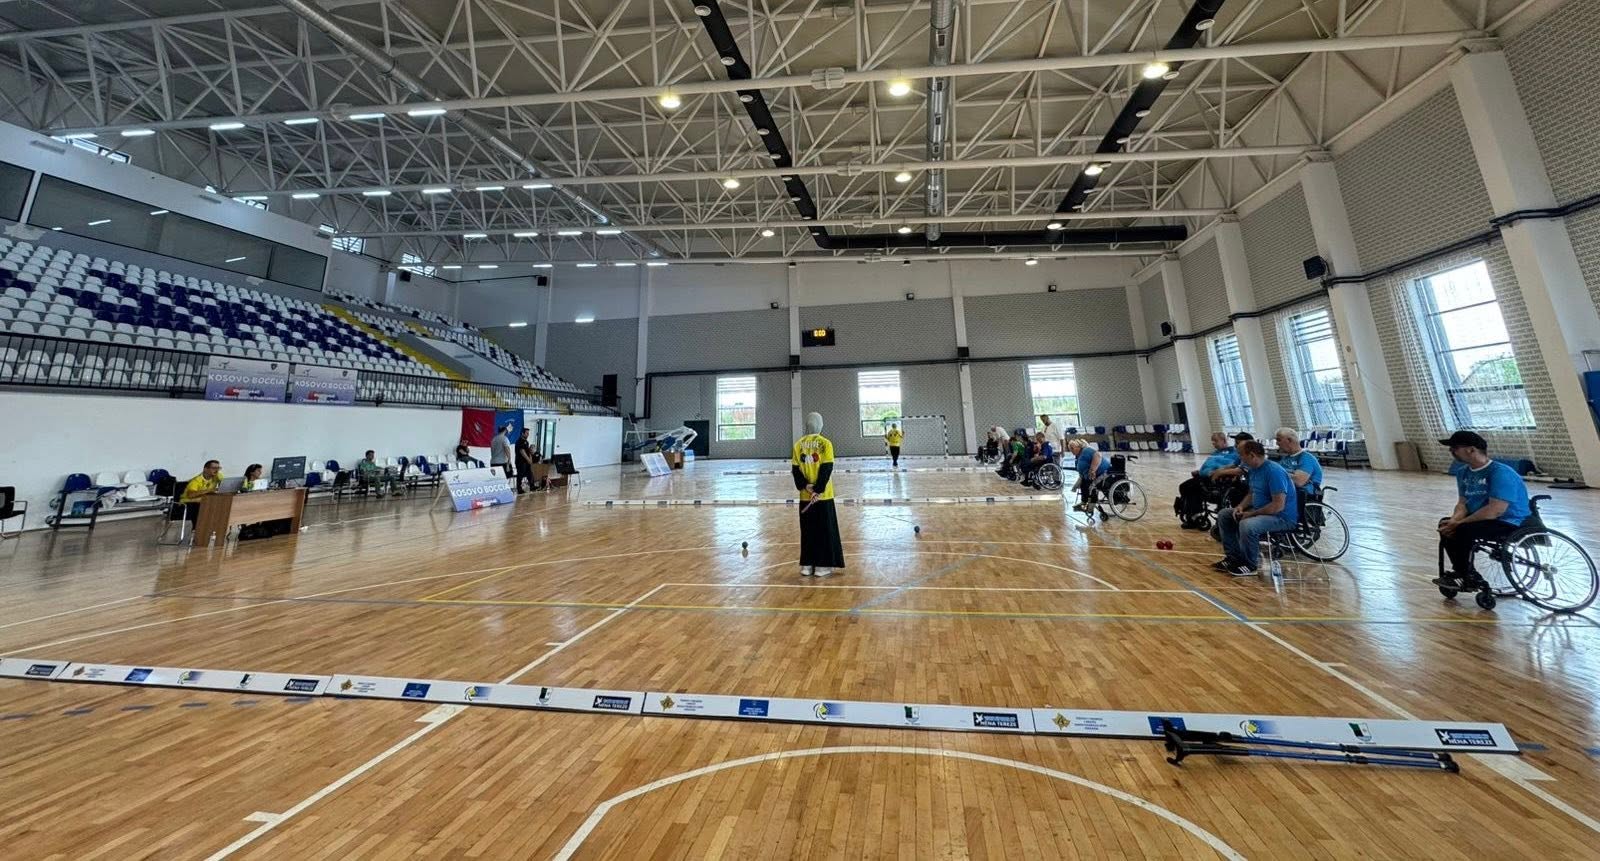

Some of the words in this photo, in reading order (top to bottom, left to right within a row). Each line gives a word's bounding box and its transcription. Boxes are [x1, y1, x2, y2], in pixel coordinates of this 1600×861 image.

[208, 374, 249, 383] KOSOVO
[251, 376, 285, 385] BOCCIA
[328, 382, 355, 390] BOCCIA
[450, 486, 483, 497] KOSOVO
[484, 483, 511, 494] BOCCIA
